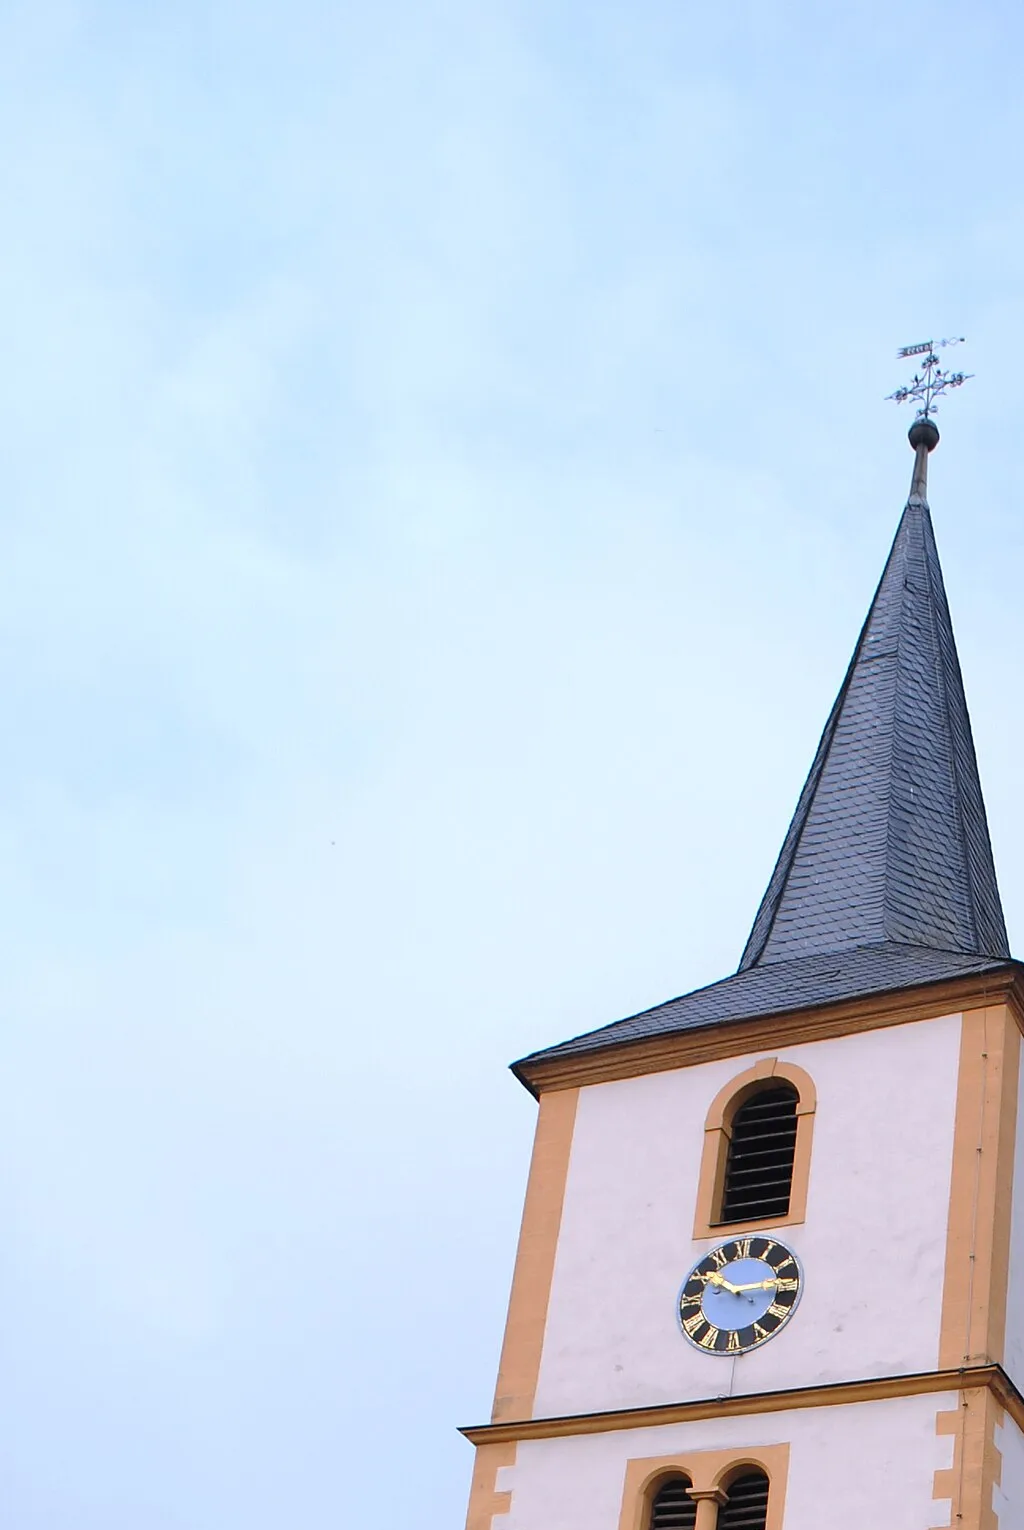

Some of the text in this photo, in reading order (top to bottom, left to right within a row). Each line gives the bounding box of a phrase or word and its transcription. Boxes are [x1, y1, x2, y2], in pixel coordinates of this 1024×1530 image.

[709, 1247, 727, 1270] XI
[734, 1239, 754, 1259] XII
[758, 1241, 777, 1261] I
[773, 1255, 794, 1274] II
[681, 1293, 702, 1310] IX
[698, 1325, 719, 1349] VII
[725, 1331, 742, 1350] VI
[753, 1322, 770, 1342] V
